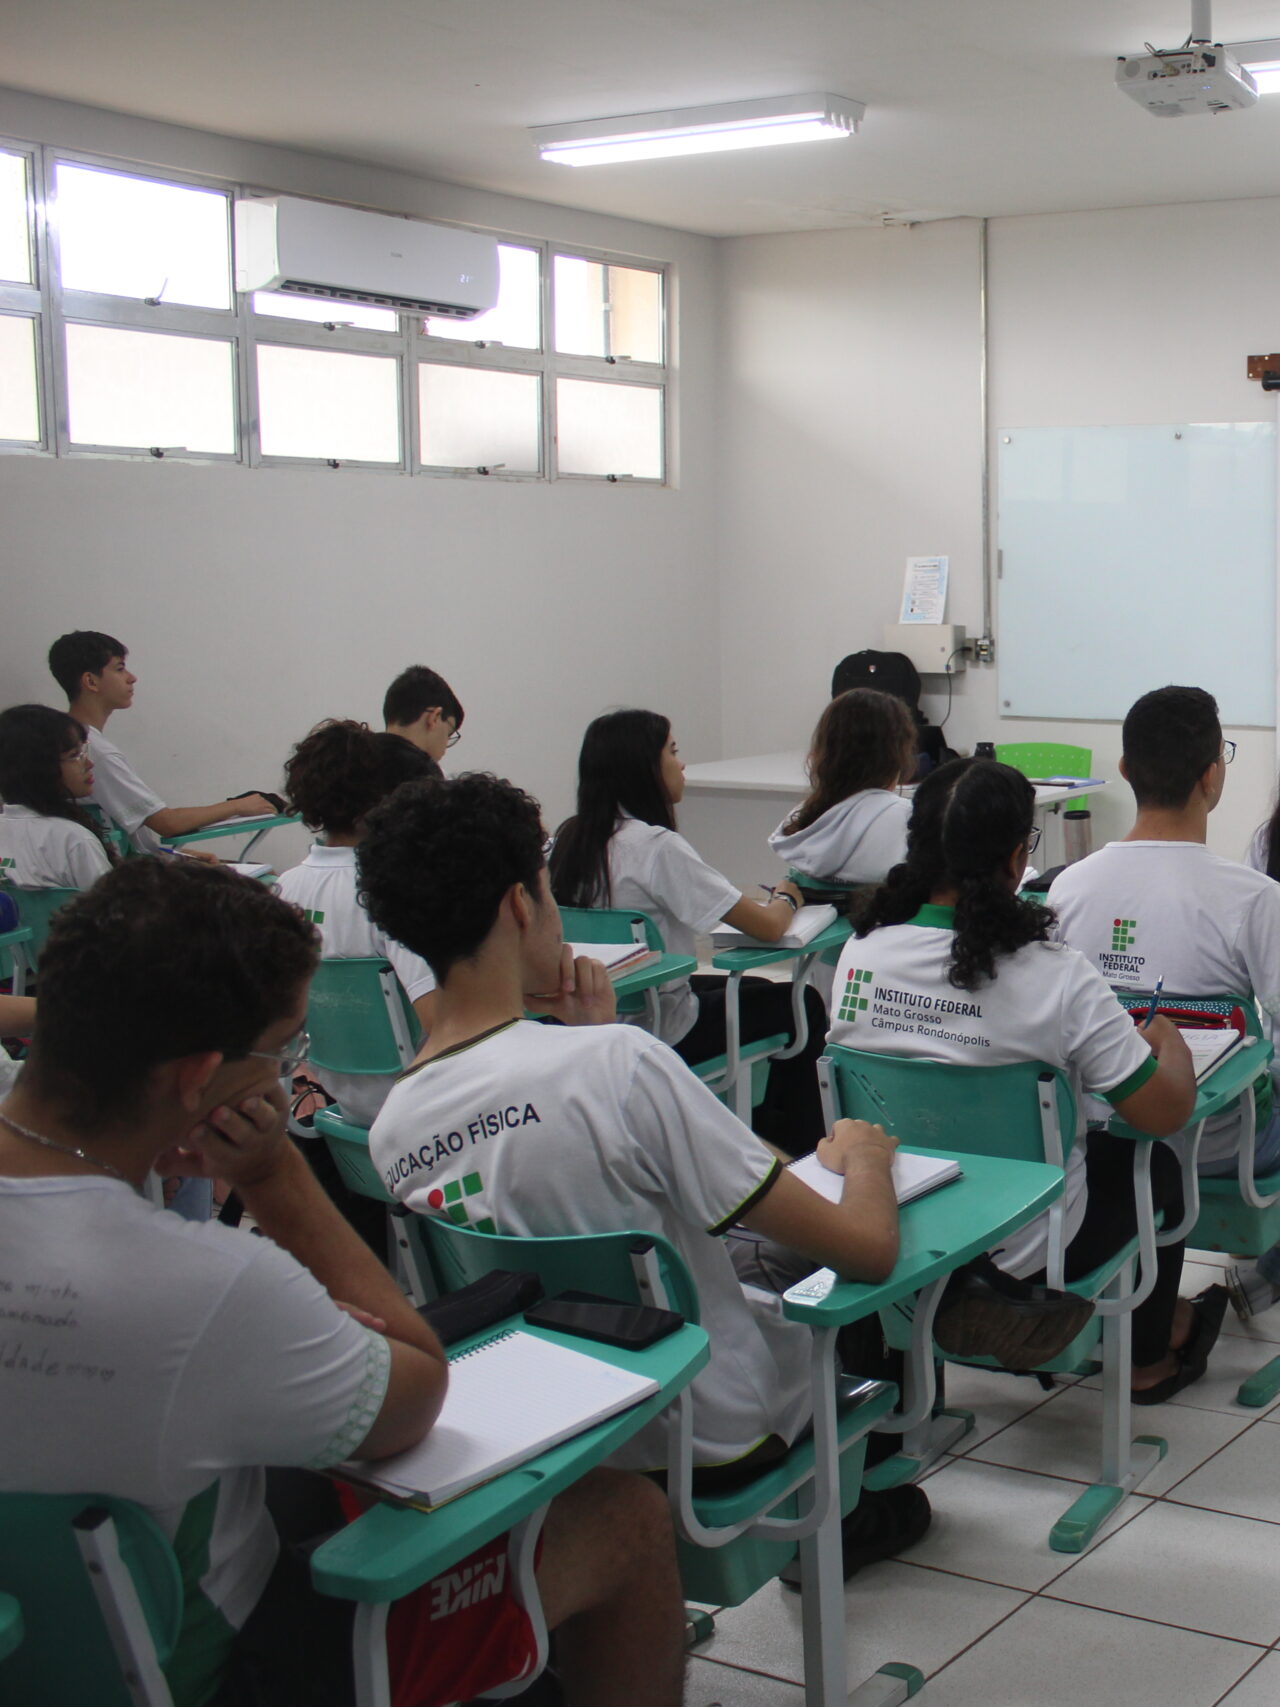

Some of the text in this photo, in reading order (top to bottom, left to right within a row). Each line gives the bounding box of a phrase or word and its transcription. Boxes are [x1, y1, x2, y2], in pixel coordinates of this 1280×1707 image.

[1099, 953, 1145, 965] INSTITUTO
[1103, 961, 1140, 973] FEDERAL
[1102, 971, 1140, 981] Mato Grosso
[872, 1003, 942, 1025] Mato Grosso
[874, 986, 983, 1018] INSTITUTO FEDERAL
[871, 1017, 991, 1048] Câmpus Rondonópolis
[467, 1102, 541, 1144] FÍSICA
[430, 1553, 507, 1621] NIKE
